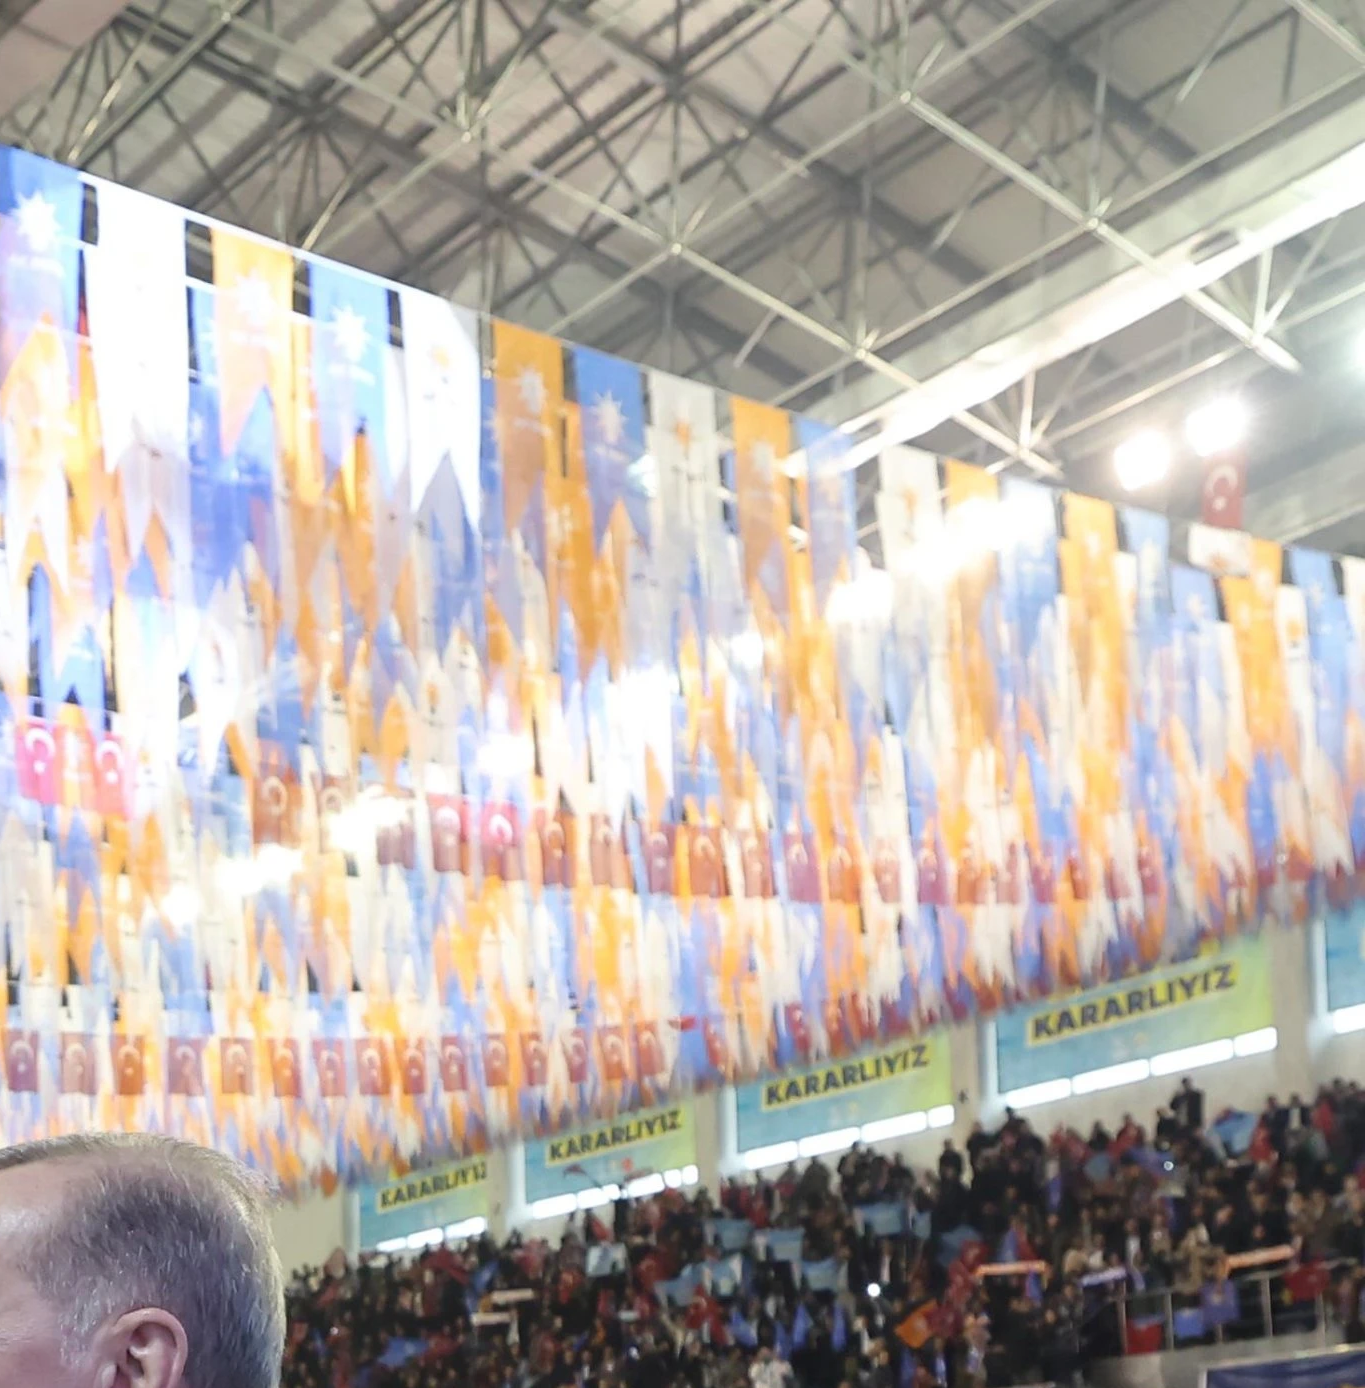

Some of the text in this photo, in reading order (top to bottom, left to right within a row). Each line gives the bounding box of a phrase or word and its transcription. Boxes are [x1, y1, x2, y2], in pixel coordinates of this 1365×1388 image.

[1032, 961, 1237, 1040] KARARLIYIZ
[765, 1044, 930, 1106] KARARLIYIZ
[548, 1110, 682, 1162] KARARLIYIZ
